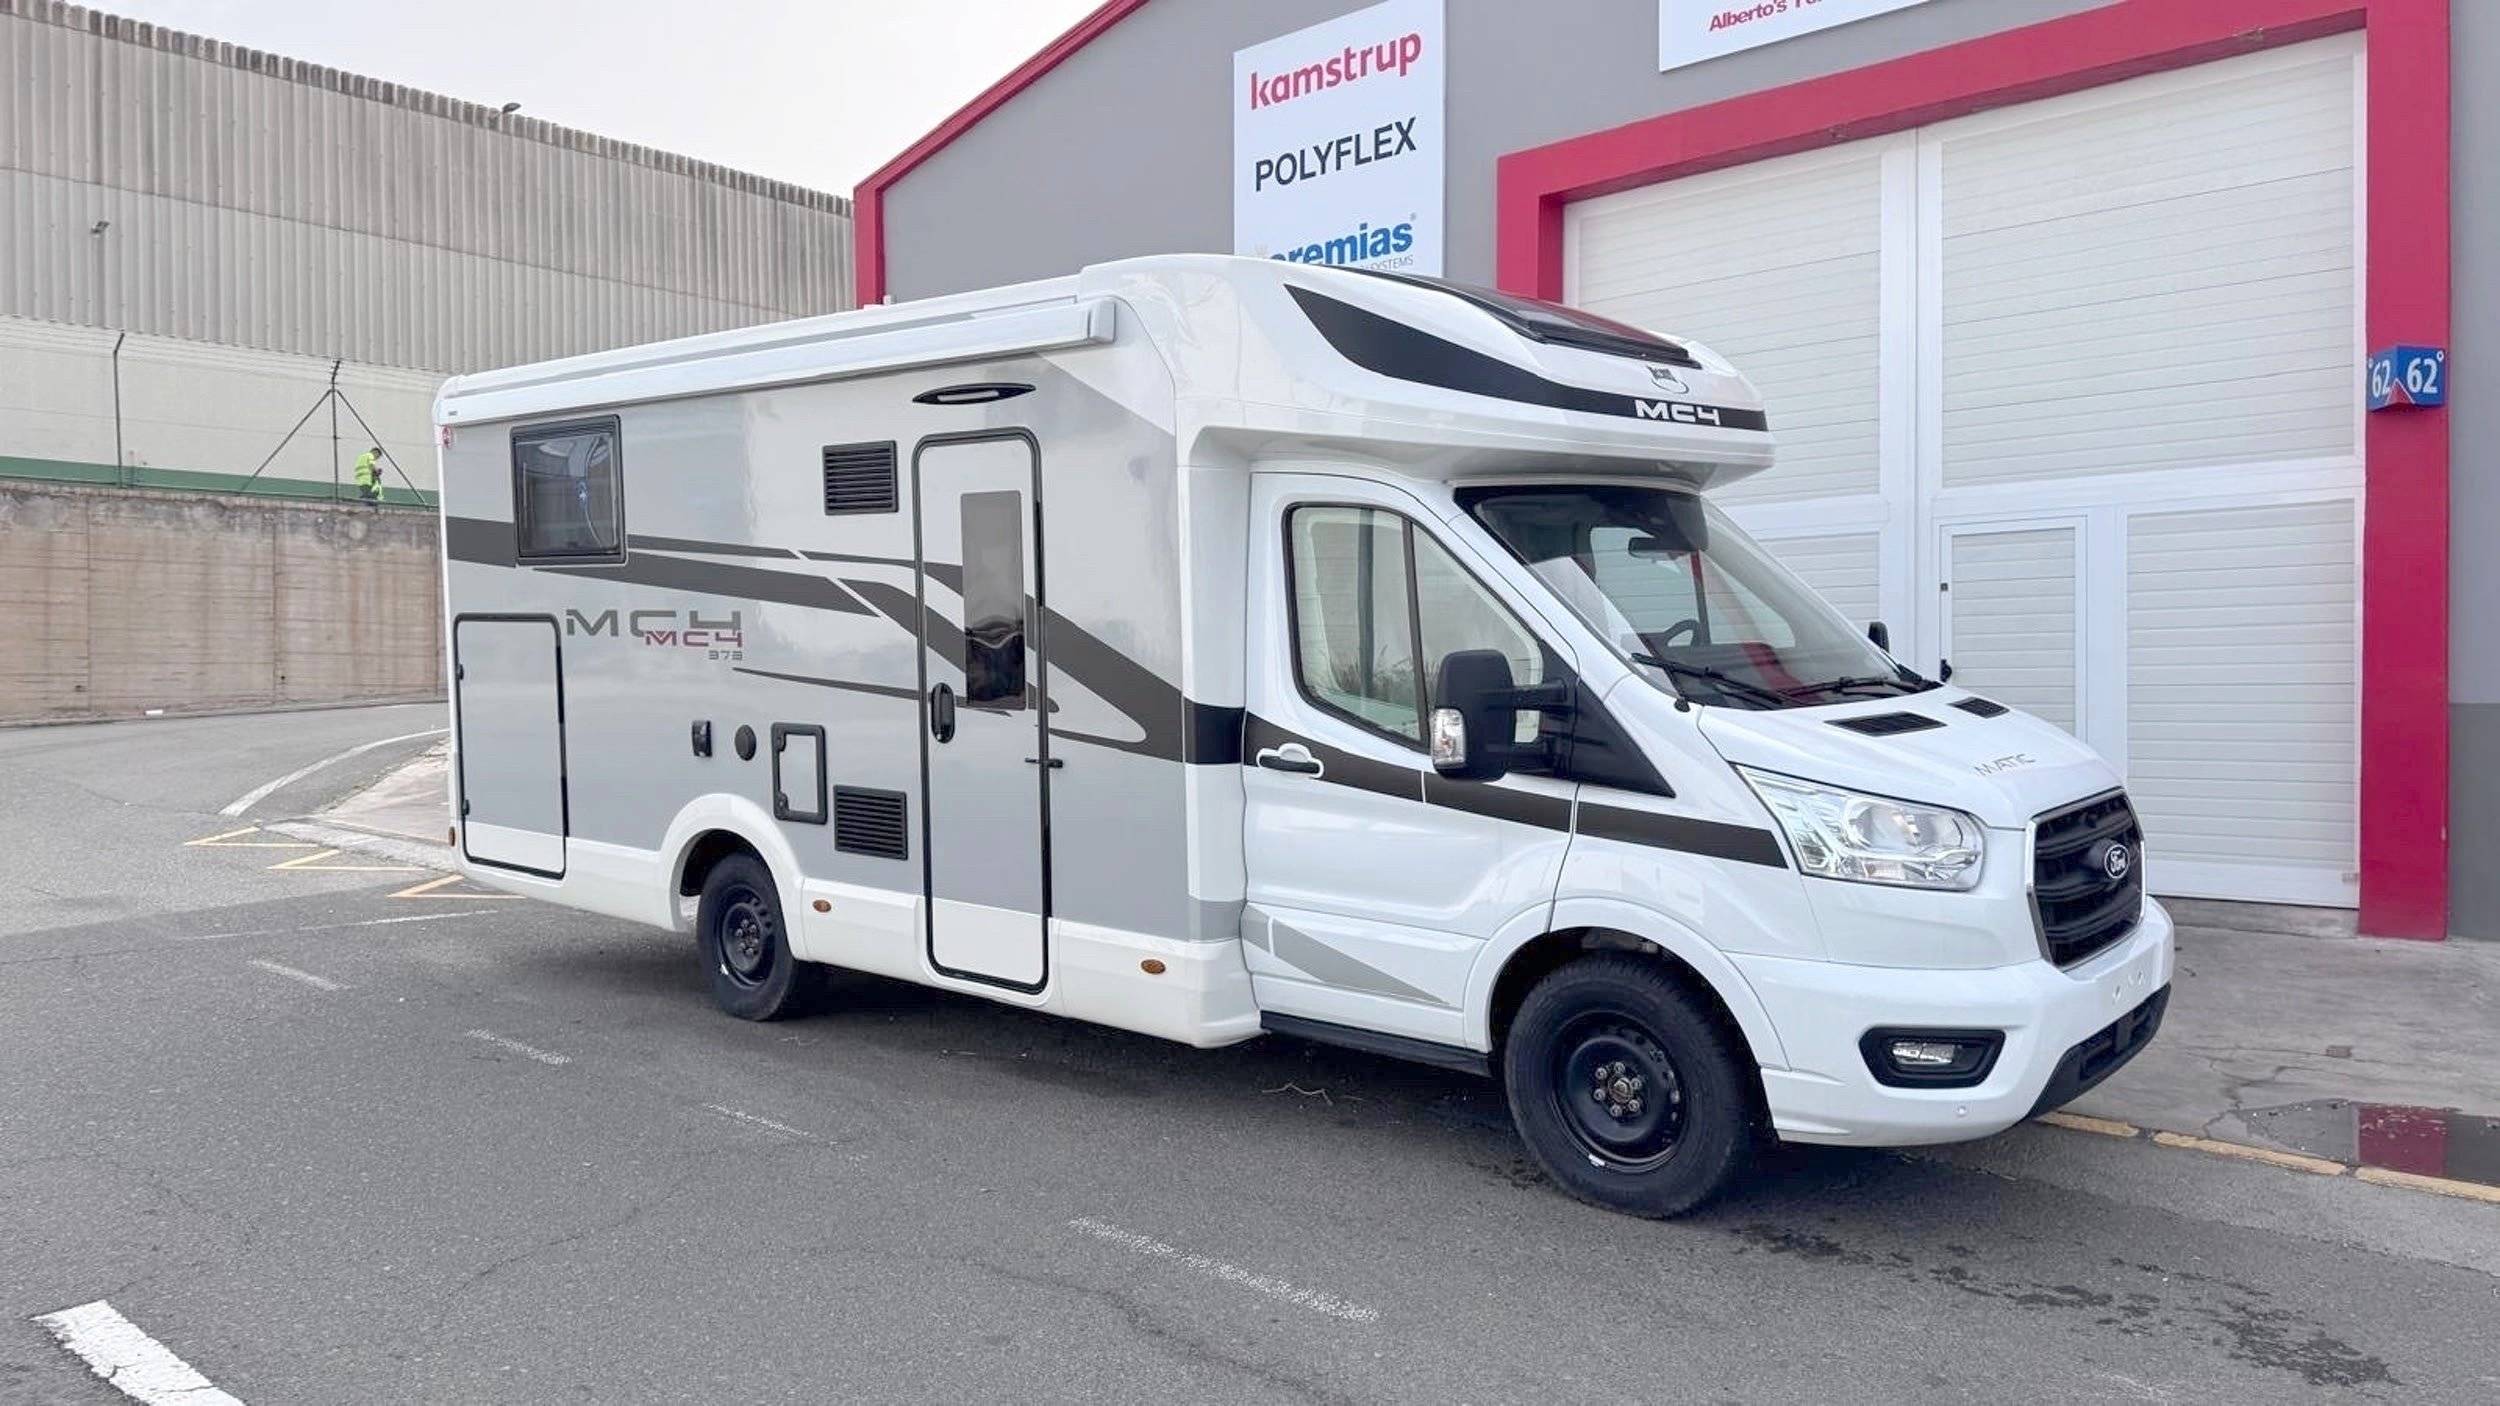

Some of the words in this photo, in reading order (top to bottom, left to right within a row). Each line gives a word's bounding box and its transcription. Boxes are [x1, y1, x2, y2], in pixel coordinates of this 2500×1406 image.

[1251, 33, 1421, 111] kamstrup
[1255, 116, 1417, 192] POLYFLEX
[1634, 399, 1721, 426] MC4
[566, 609, 742, 638] MC4
[645, 630, 743, 648] MC4
